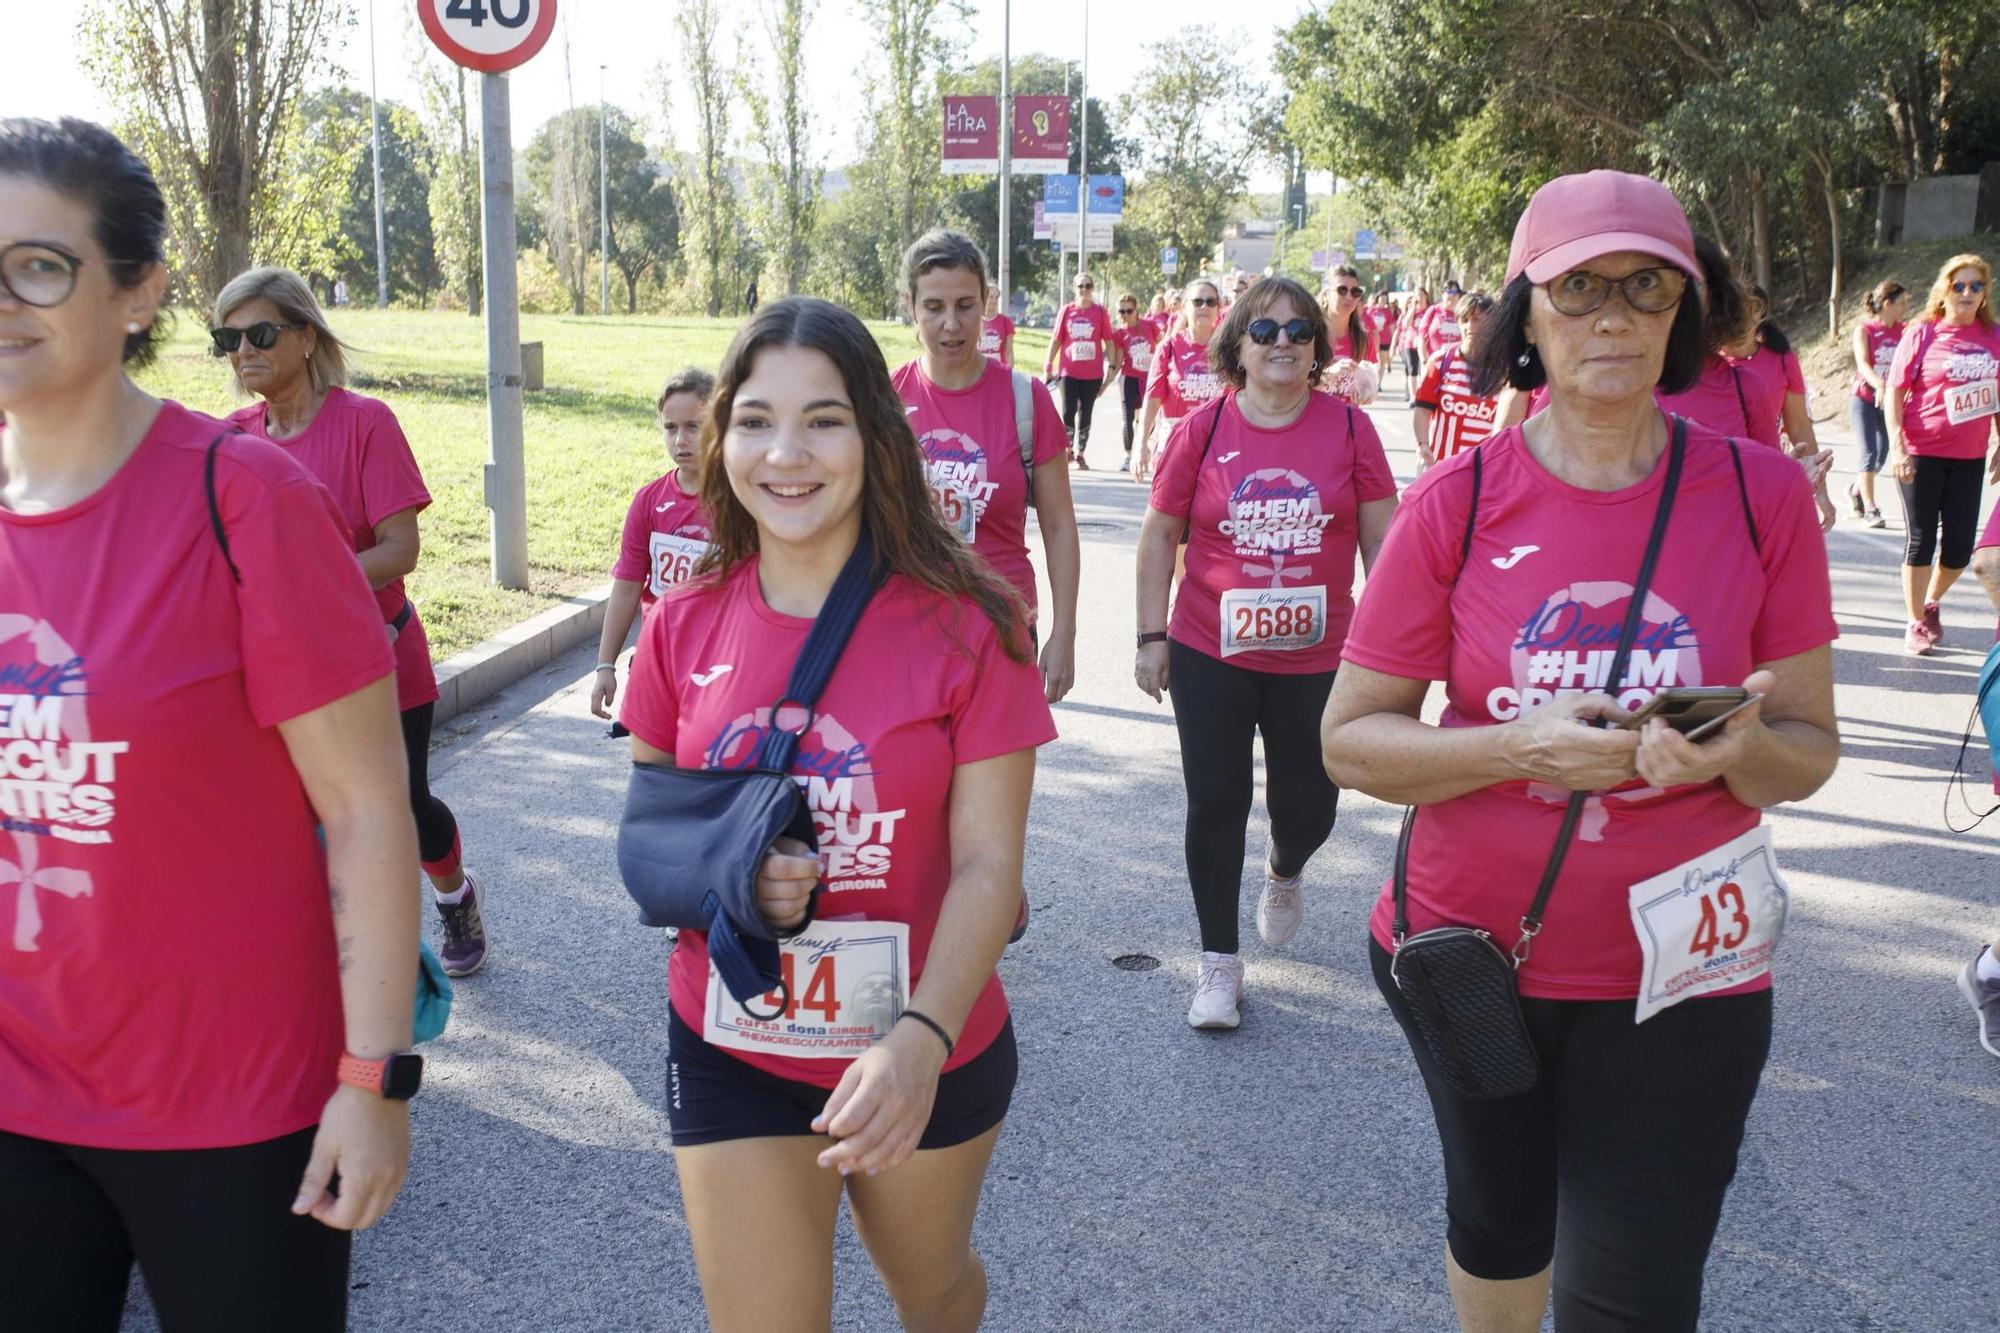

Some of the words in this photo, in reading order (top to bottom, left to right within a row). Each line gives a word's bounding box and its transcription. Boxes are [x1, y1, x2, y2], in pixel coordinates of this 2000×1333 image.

[446, 0, 530, 28] 40
[947, 103, 968, 118] LA
[947, 117, 986, 131] FIRA
[1955, 388, 1991, 412] 4470
[1237, 498, 1311, 519] #HEM
[1233, 527, 1323, 549] JUNTES
[1235, 604, 1313, 640] 2688
[0, 739, 130, 784] CUT
[828, 878, 888, 893] GIRONA
[1689, 882, 1750, 957] 43
[763, 952, 842, 1023] 44
[735, 1016, 781, 1032] cursa
[787, 1023, 826, 1035] dona
